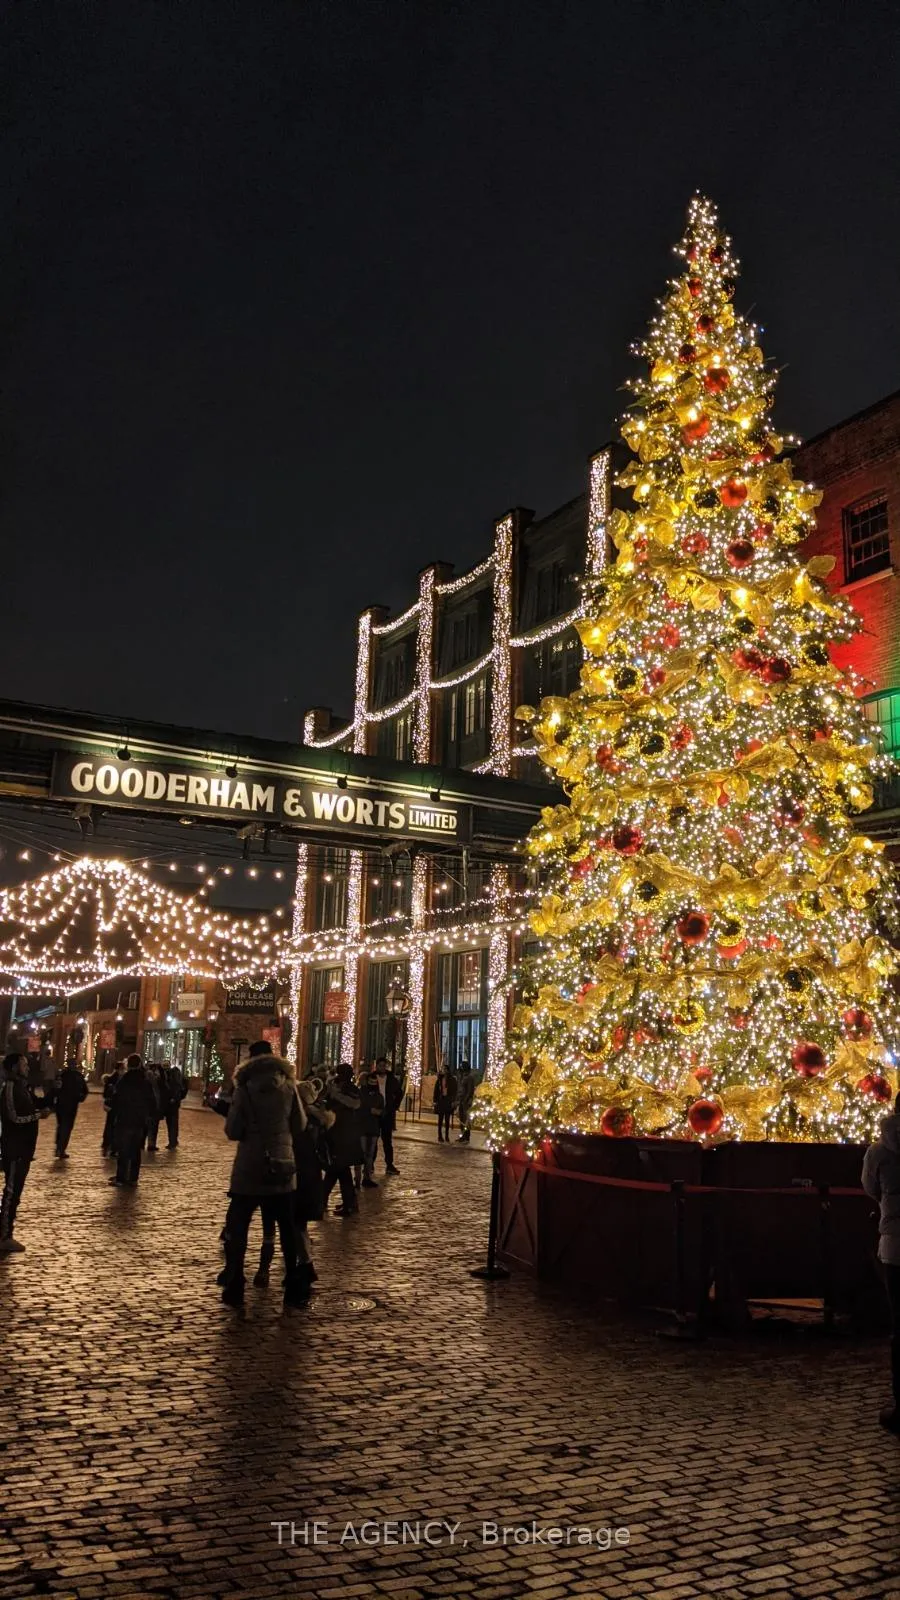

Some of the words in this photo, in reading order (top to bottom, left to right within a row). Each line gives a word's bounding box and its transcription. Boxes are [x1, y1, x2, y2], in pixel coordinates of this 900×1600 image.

[71, 762, 275, 813] GOODERHAM
[283, 789, 307, 818] &
[312, 791, 405, 829] WORTS
[409, 809, 457, 830] LIMITED
[229, 992, 246, 1000] FOR
[248, 992, 274, 1000] LEASE
